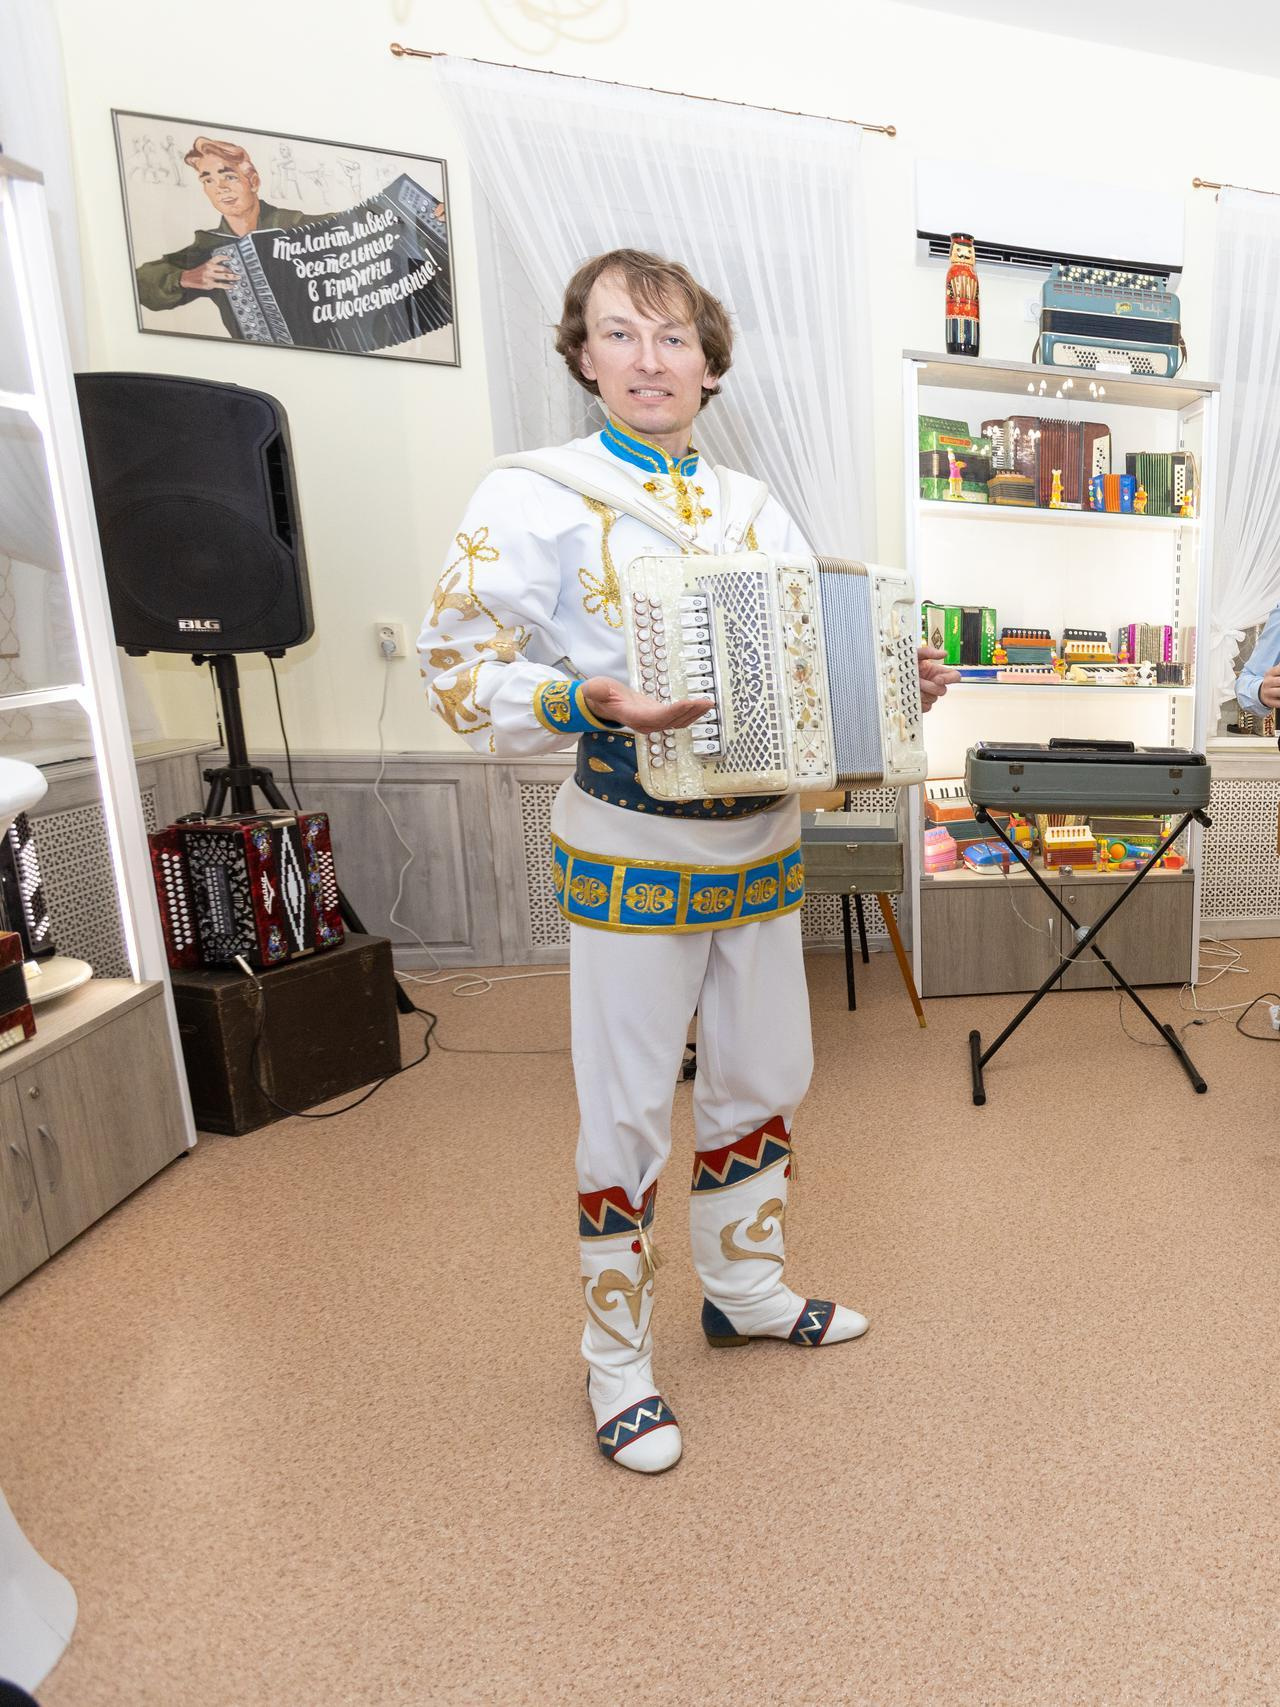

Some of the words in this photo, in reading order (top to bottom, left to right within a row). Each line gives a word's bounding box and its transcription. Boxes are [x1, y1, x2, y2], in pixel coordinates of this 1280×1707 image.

[308, 280, 320, 301] в
[323, 259, 394, 300] кружки
[312, 248, 443, 324] самодеятельные!
[178, 619, 220, 629] BLG
